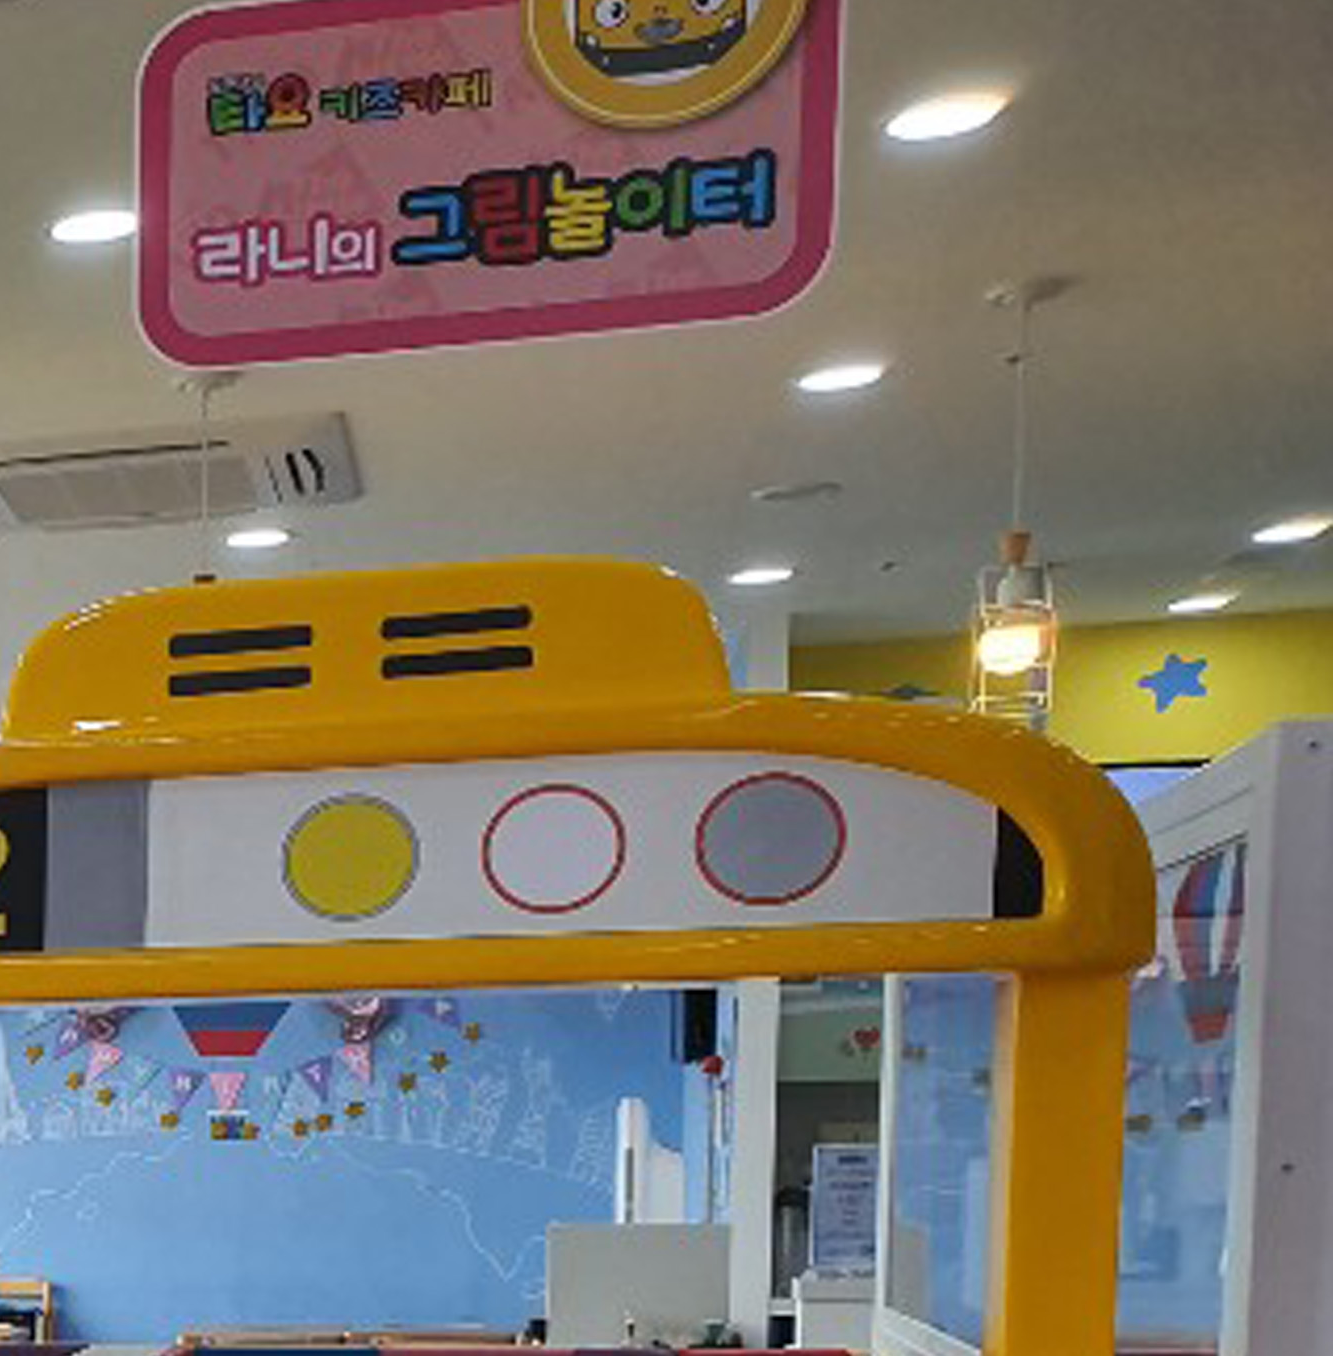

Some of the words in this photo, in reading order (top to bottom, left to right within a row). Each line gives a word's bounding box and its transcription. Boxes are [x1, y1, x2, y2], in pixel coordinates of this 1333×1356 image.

[207, 73, 311, 135] 타요
[319, 68, 491, 122] 키즈카페
[192, 211, 382, 288] 라니의
[392, 148, 776, 266] 그림놀이터
